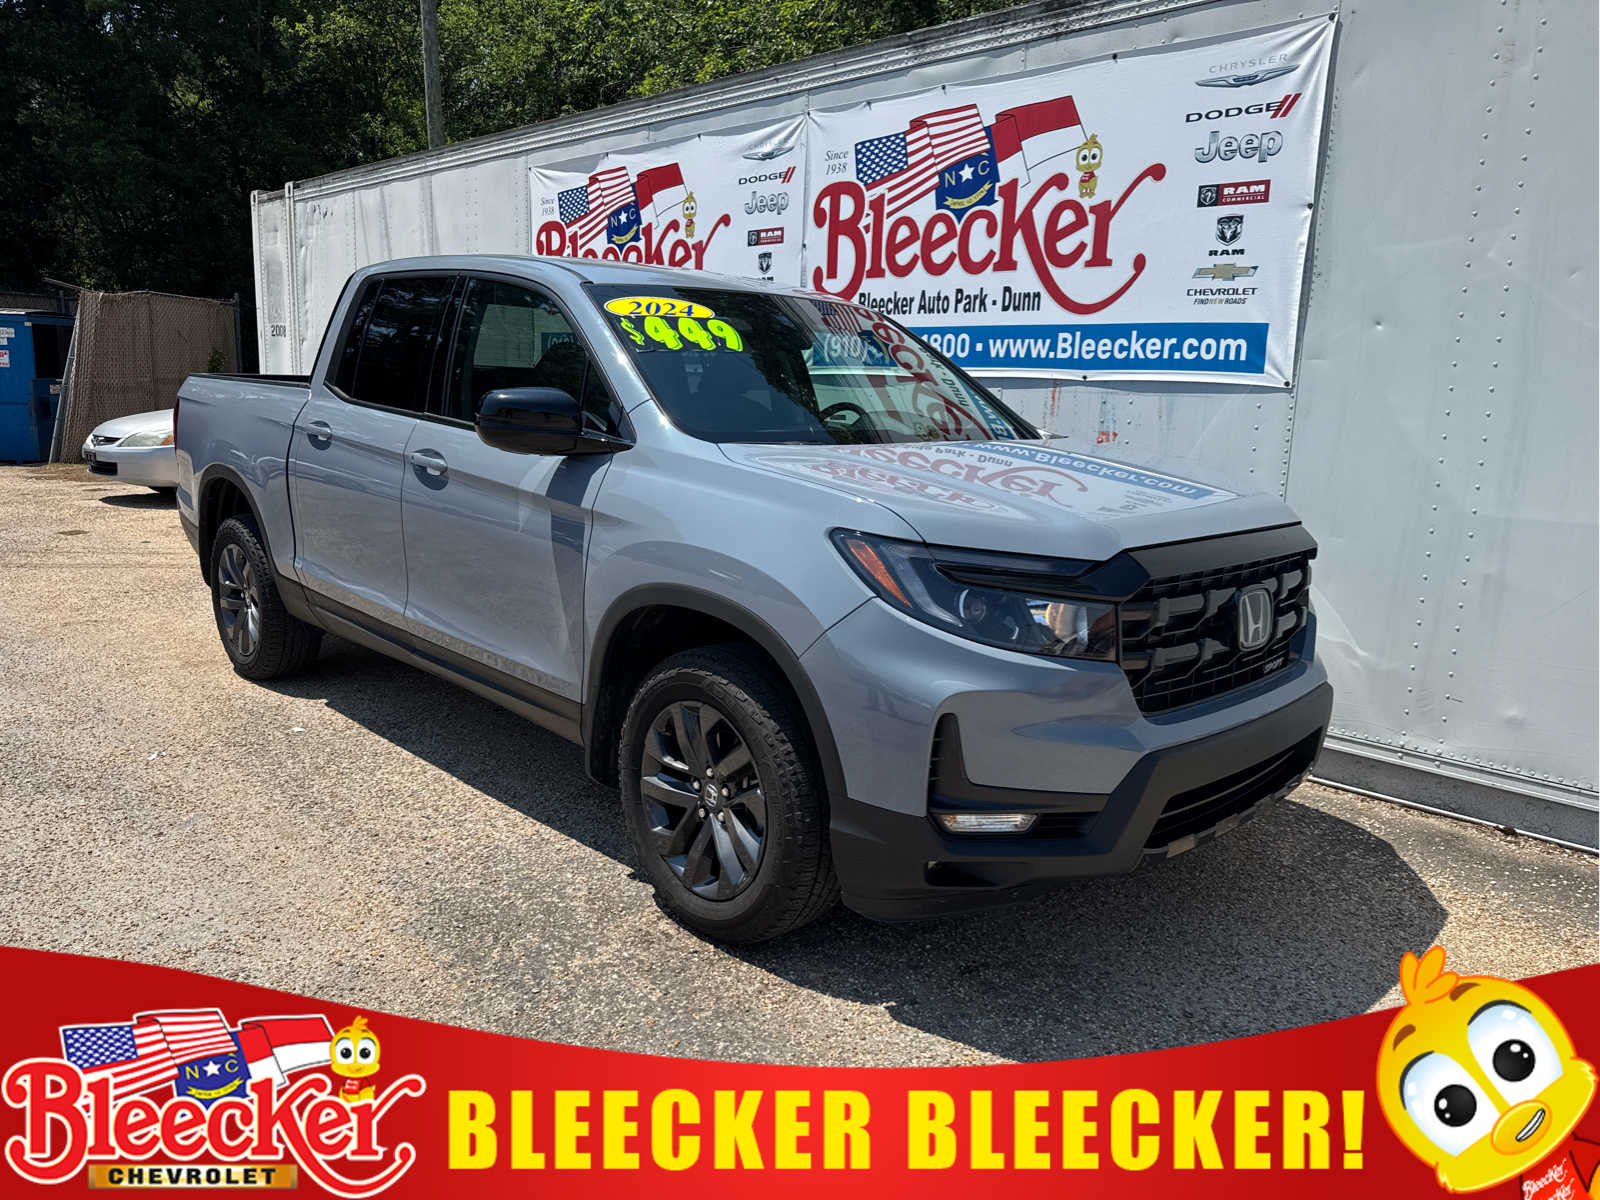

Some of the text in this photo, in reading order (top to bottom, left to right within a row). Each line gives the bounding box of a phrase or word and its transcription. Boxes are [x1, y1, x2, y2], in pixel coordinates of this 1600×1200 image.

[1208, 53, 1288, 74] CHRYSLER
[1185, 101, 1284, 123] DODGE
[825, 150, 849, 161] Since
[1194, 130, 1283, 163] Jeep
[738, 171, 786, 185] DODGE
[825, 162, 847, 175] 1938
[945, 160, 990, 188] N C
[1223, 184, 1265, 195] RAM
[744, 191, 789, 215] Jeep
[813, 163, 1166, 314] Bleecker
[1208, 248, 1245, 257] RAM
[858, 286, 1042, 315] Bleecker Auto Park Dunn
[1186, 287, 1258, 296] CHEVROLET
[628, 301, 695, 316] 2024
[988, 330, 1248, 361] www.Bleecker.com
